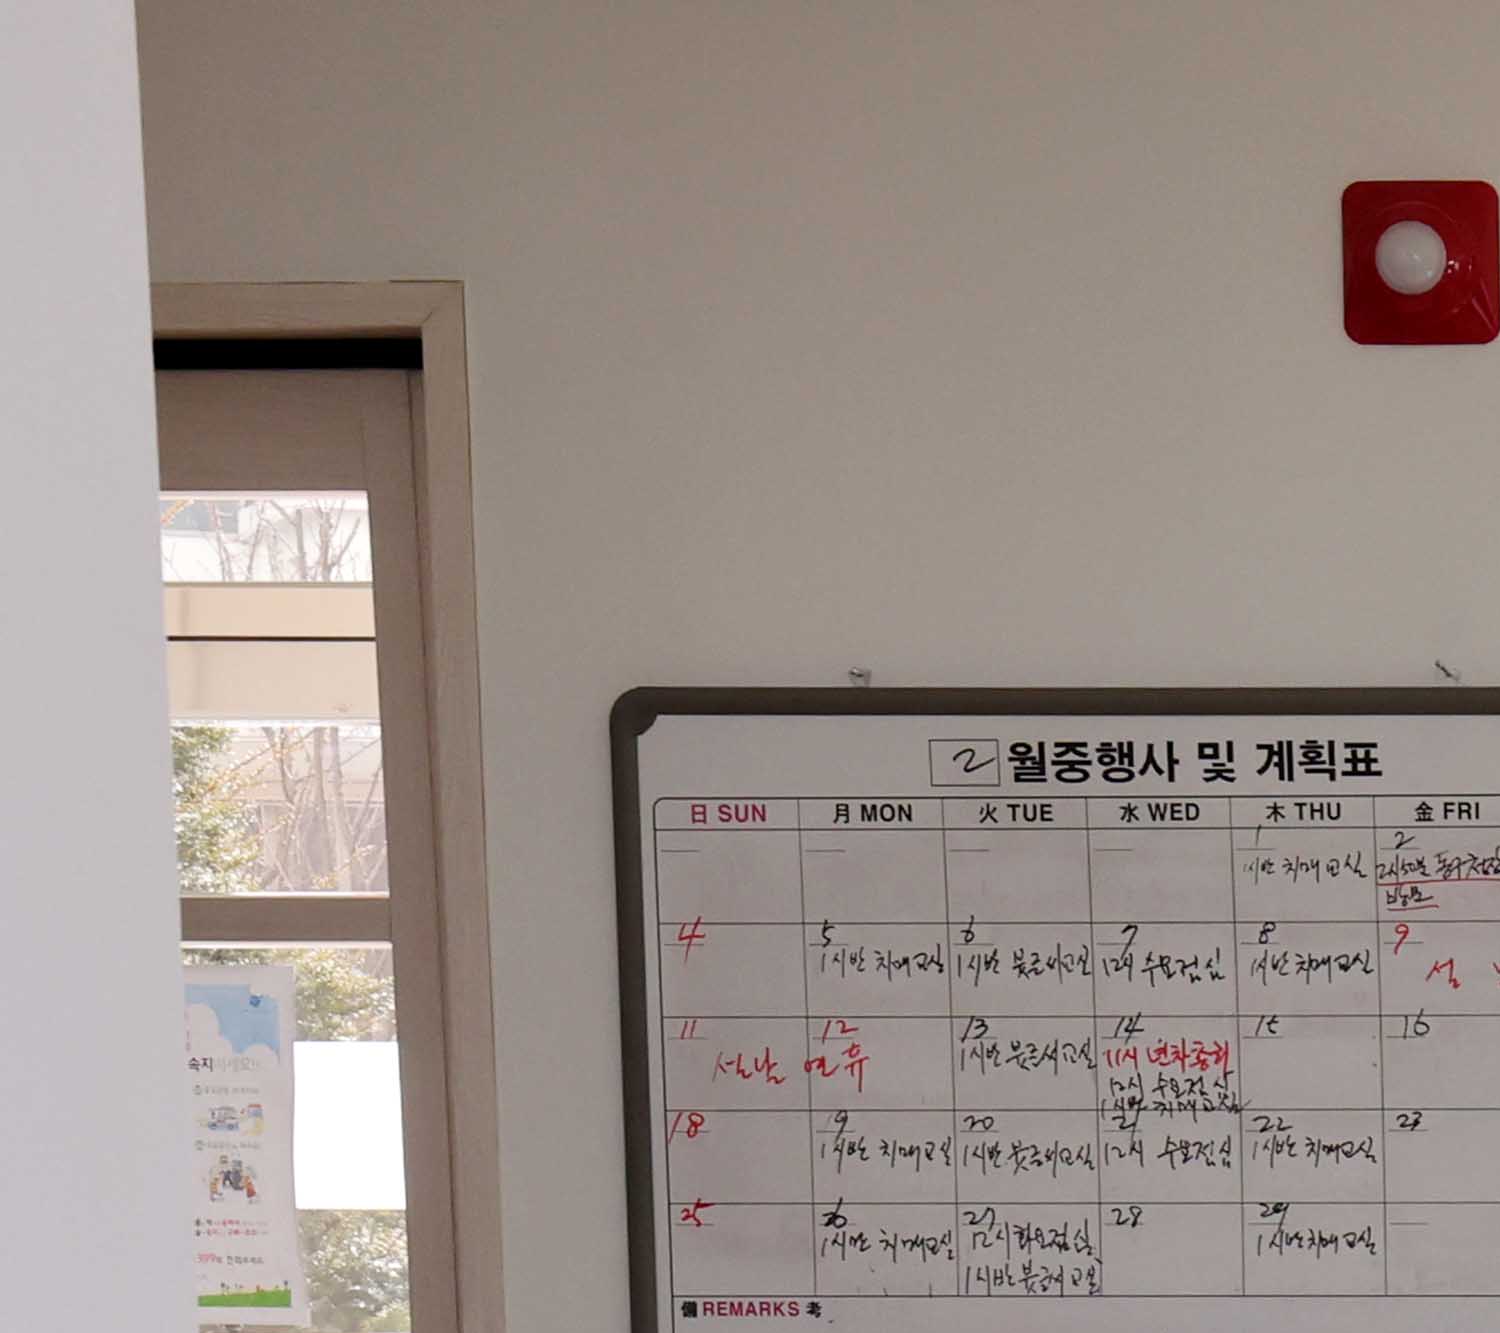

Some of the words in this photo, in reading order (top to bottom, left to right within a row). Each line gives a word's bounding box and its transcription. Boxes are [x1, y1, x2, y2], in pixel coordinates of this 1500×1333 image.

[952, 748, 996, 773] 2
[1007, 740, 1180, 785] 월중행사
[1198, 740, 1238, 783] 및
[1256, 739, 1383, 781] 계획표
[690, 805, 708, 824] 日
[717, 804, 767, 823] SUN
[833, 804, 851, 824] 月
[860, 804, 913, 823] MON
[979, 804, 998, 824] 火
[1007, 803, 1054, 822] TUE
[1119, 803, 1139, 823] 水
[1147, 803, 1200, 822] WED
[1265, 802, 1285, 823] 木
[1294, 802, 1342, 821] THU
[1415, 802, 1434, 823] 金
[1443, 802, 1481, 820] FRI
[1394, 831, 1415, 849] 2
[678, 916, 704, 962] 4
[822, 920, 835, 947] 5
[960, 914, 975, 943] 6
[1259, 922, 1276, 944] 8
[1395, 924, 1409, 955] 9
[1121, 925, 1138, 960] 7
[822, 1020, 859, 1044] 12
[960, 1016, 989, 1043] 13
[1114, 1012, 1144, 1045] 14
[1402, 1008, 1430, 1039] 16
[668, 1112, 704, 1144] 18
[964, 1115, 994, 1131] 20
[1252, 1115, 1292, 1133] 22
[963, 1207, 996, 1232] 27
[1111, 1206, 1143, 1226] 28
[703, 1301, 800, 1317] REMARKS
